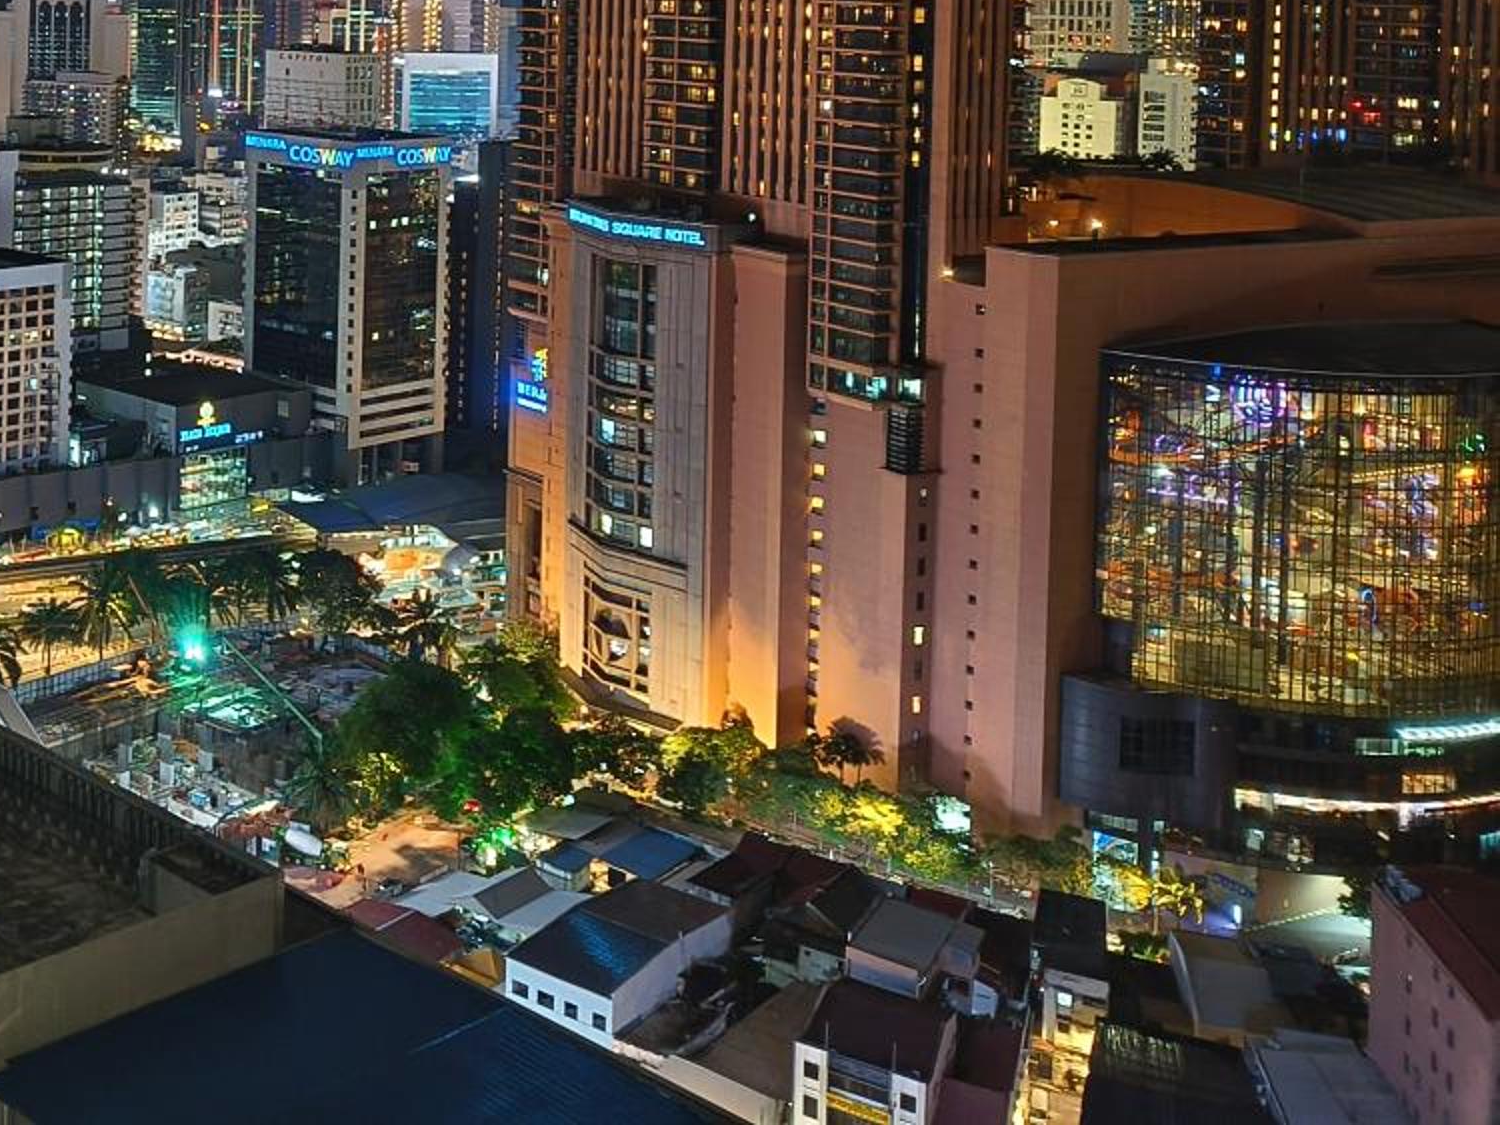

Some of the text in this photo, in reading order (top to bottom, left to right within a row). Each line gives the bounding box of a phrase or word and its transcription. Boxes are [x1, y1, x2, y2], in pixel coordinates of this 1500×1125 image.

[289, 144, 354, 167] COSWAY
[398, 146, 450, 165] COSWAY
[612, 222, 705, 245] SQUARE HOTEL
